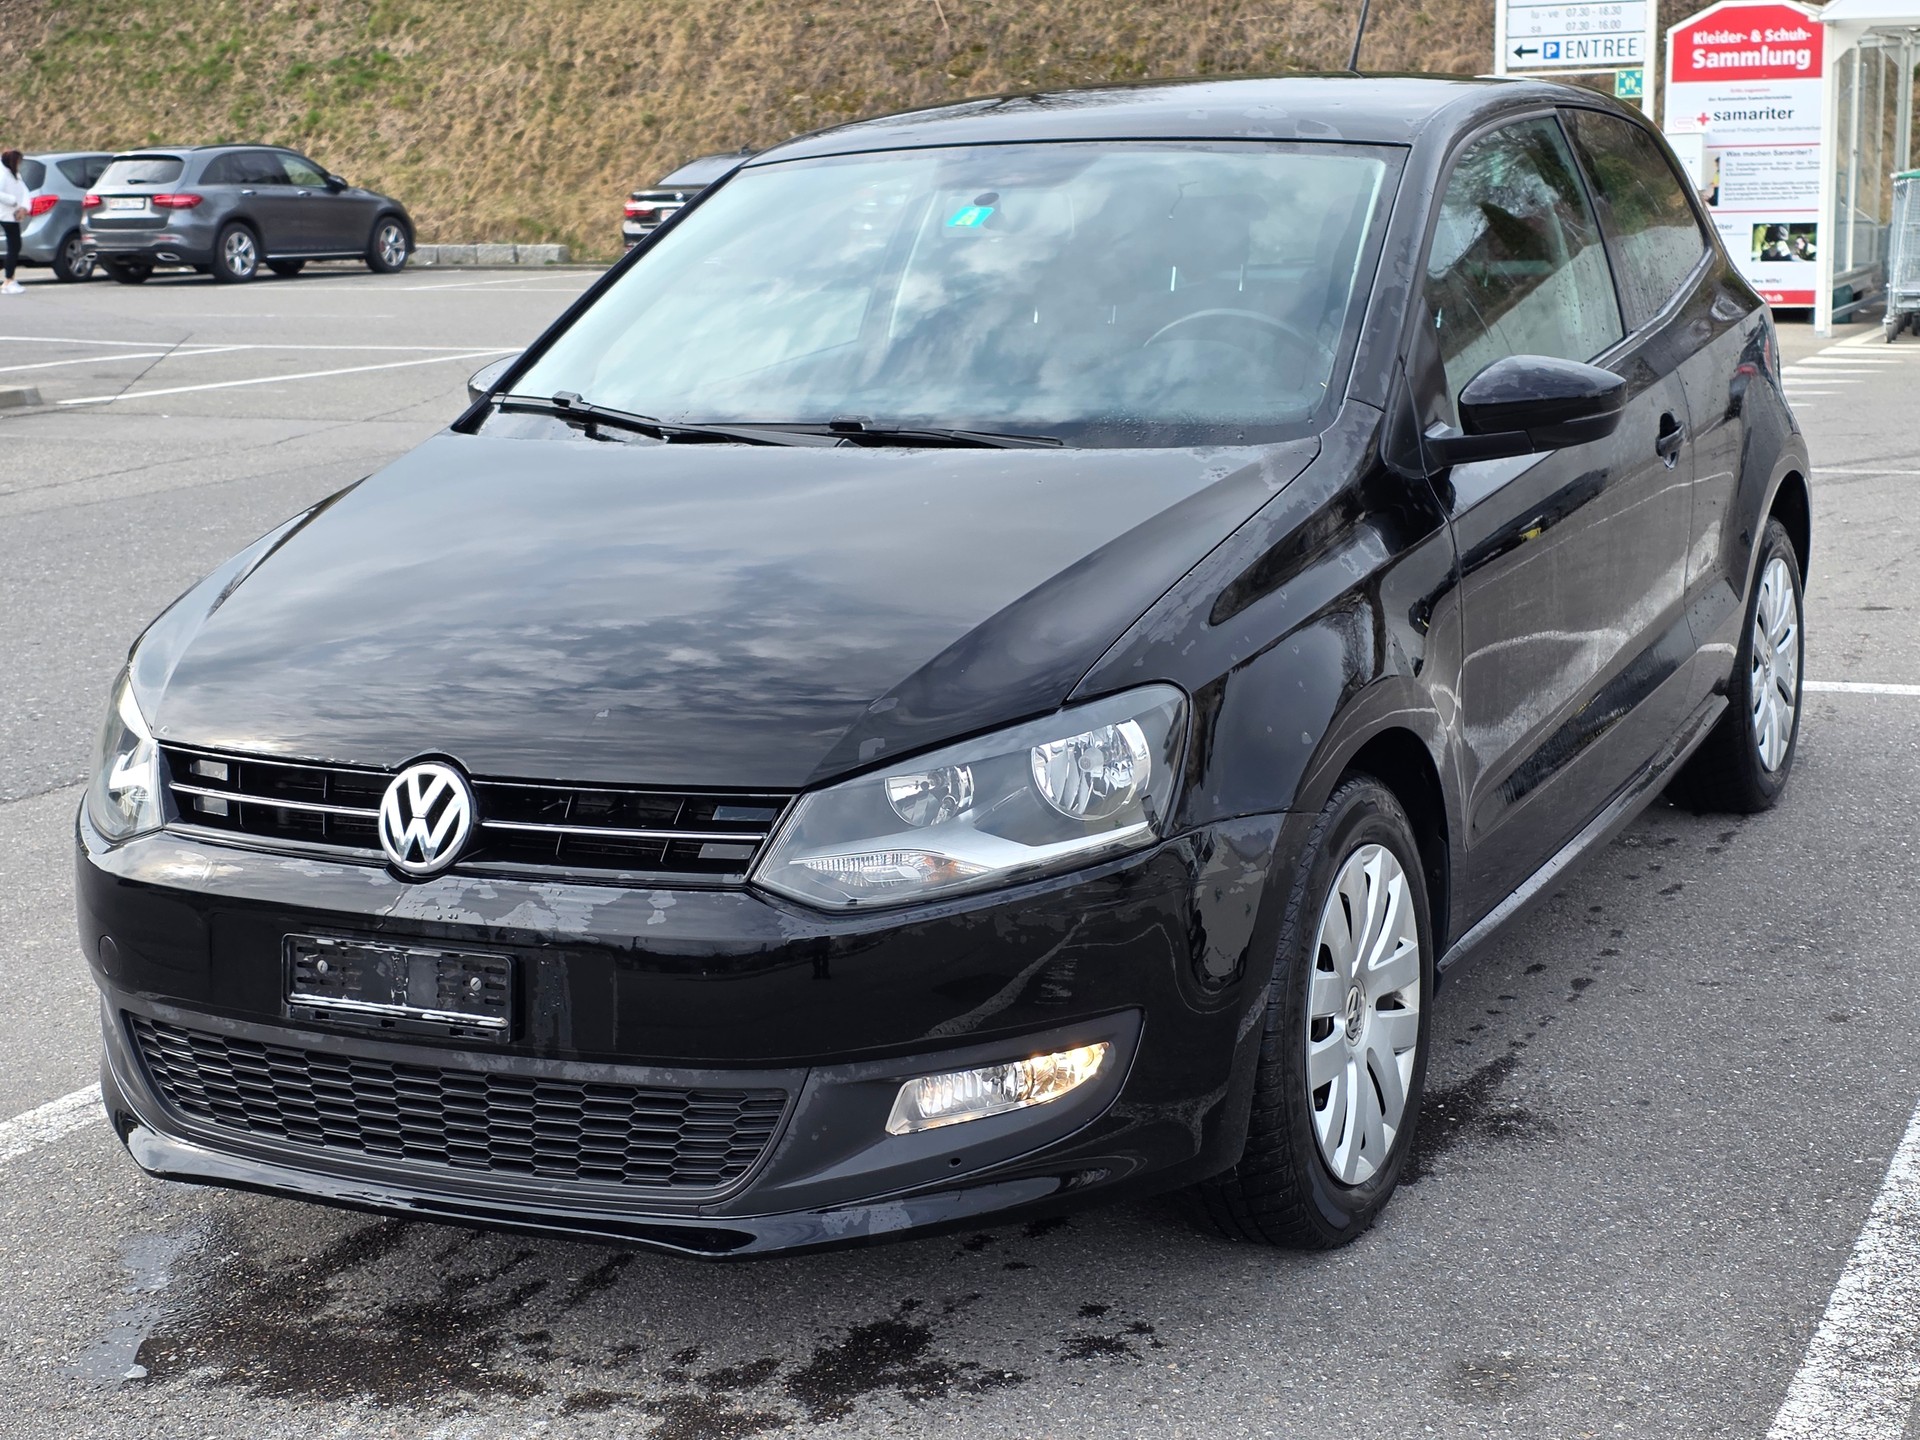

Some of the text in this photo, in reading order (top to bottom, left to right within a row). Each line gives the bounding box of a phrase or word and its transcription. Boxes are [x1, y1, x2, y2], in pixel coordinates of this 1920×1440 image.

[1566, 21, 1590, 32] 07.30
[1692, 26, 1812, 45] Kleider- & Schuh-
[1566, 38, 1638, 59] ENTREE
[1692, 45, 1811, 70] Sammlung
[1713, 106, 1795, 122] samariter
[1773, 148, 1813, 156] Samariter?
